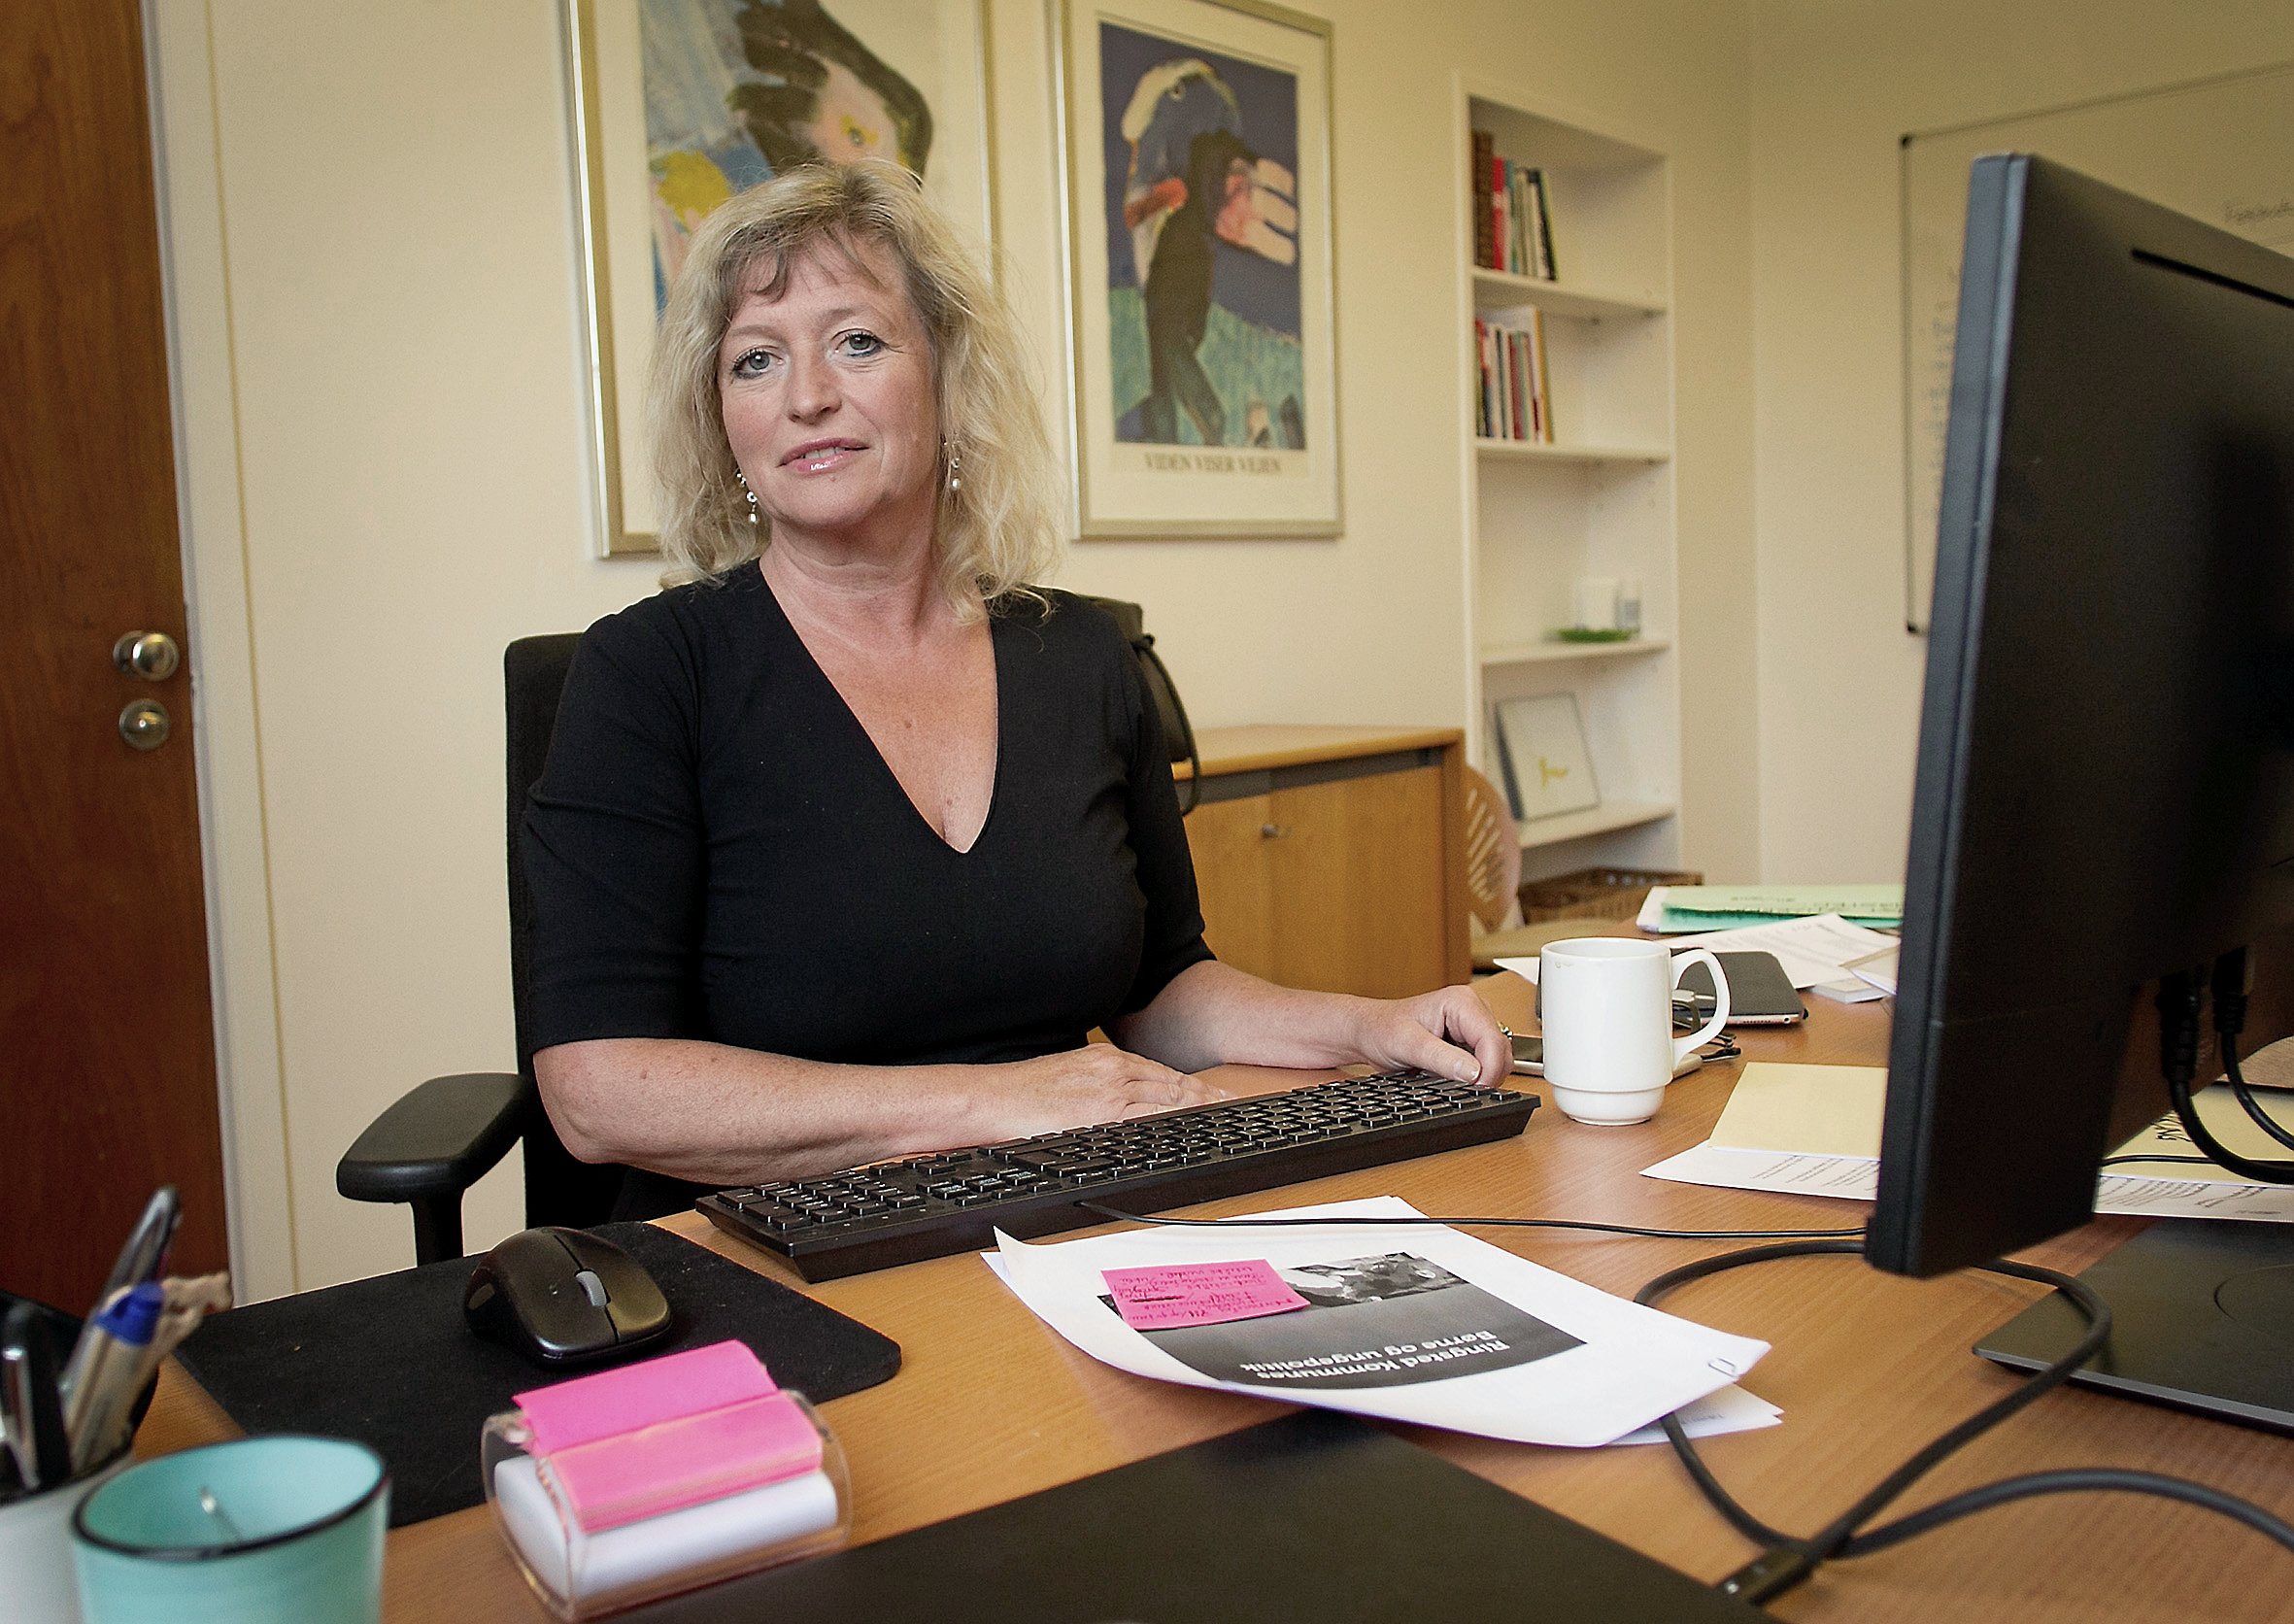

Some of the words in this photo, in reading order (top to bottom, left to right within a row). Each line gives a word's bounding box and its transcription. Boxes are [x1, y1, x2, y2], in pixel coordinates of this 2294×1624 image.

[1421, 1330, 1498, 1349] Børne
[1382, 1344, 1418, 1356] og
[1399, 1340, 1510, 1368] Ringsted
[1239, 1350, 1382, 1371] ungepolitik
[1257, 1360, 1400, 1379] Kommunes
